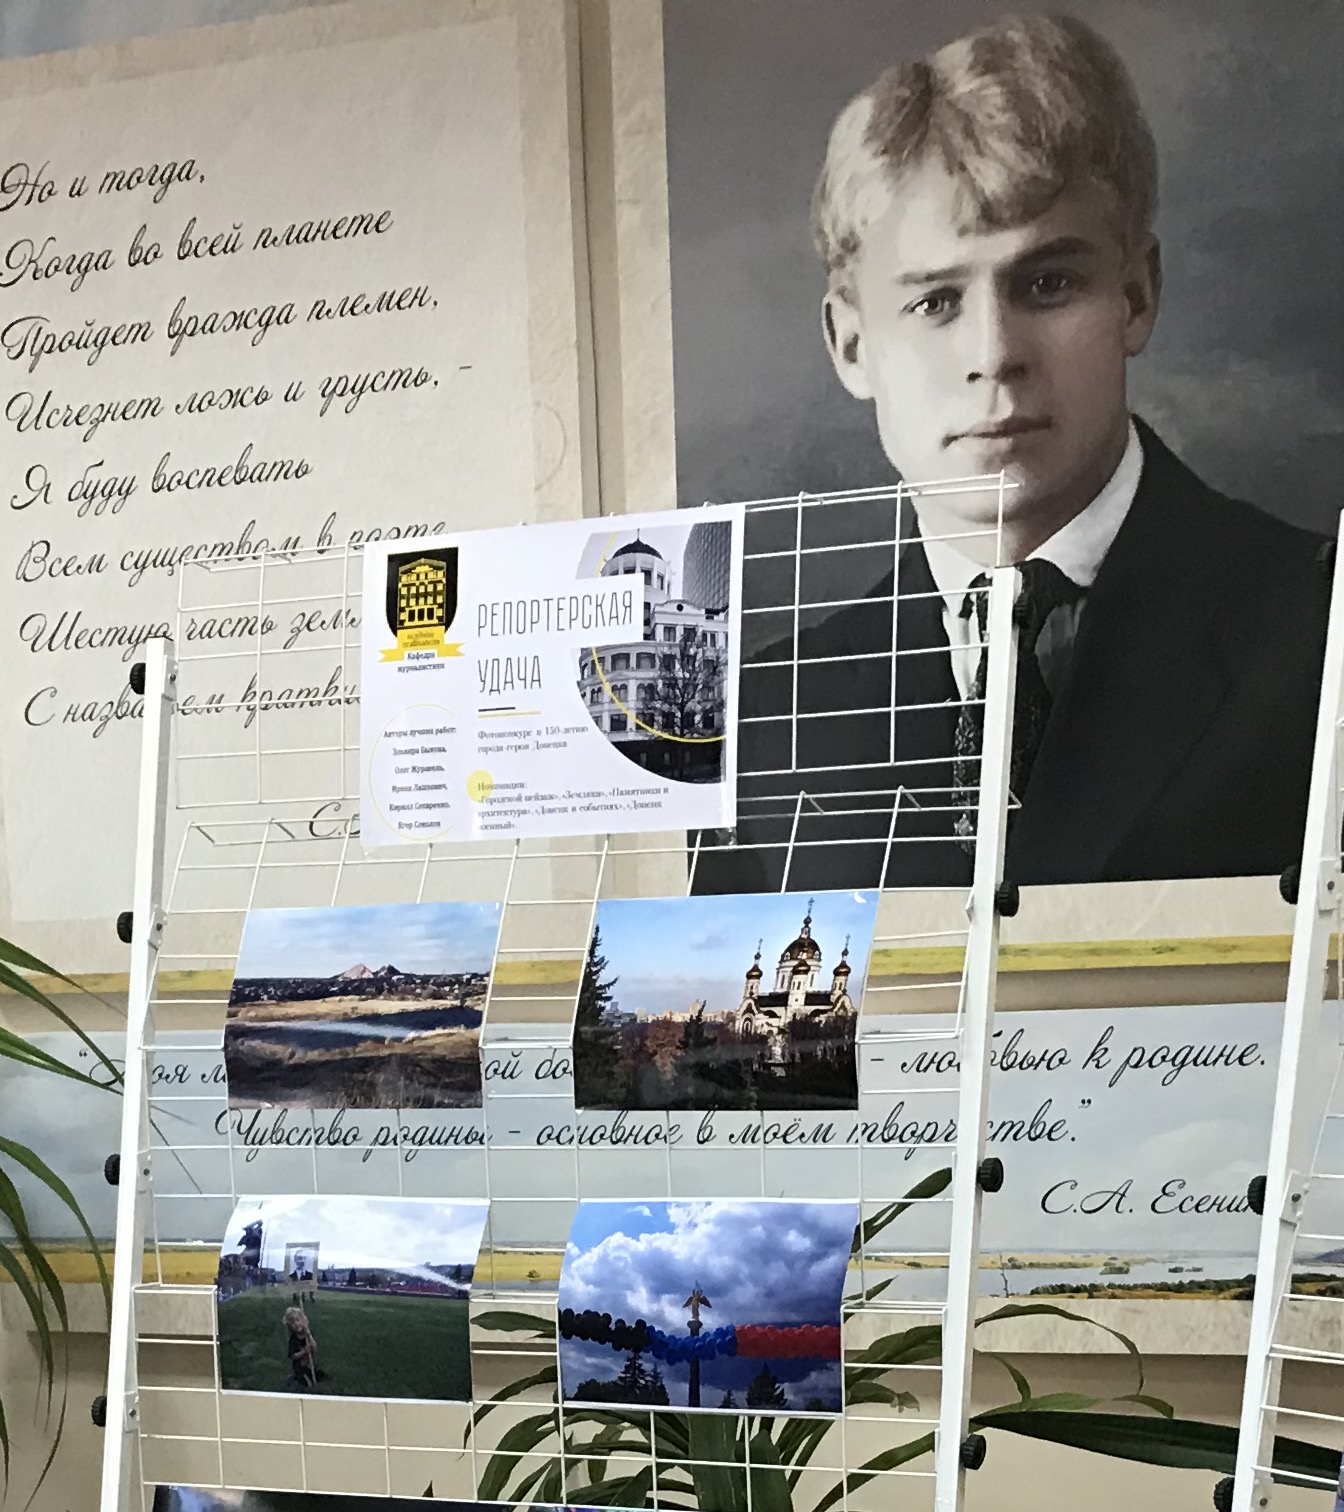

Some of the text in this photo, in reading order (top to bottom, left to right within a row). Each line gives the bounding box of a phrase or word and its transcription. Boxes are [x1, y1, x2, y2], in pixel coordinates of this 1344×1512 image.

[69, 176, 89, 198] и
[99, 159, 205, 204] тогда,
[128, 223, 164, 267] во
[177, 217, 244, 260] всей
[253, 210, 394, 250] планете
[0, 285, 439, 374] Пройдет вражда племен,
[5, 390, 164, 443] Исчезнет
[175, 384, 274, 415] ложь
[284, 381, 306, 403] и
[319, 366, 439, 418] грусть,
[10, 443, 314, 518] Я буду воспевать
[15, 540, 108, 583] Всем
[120, 519, 303, 588] существом
[317, 511, 337, 555] в
[19, 611, 173, 663] Шестую
[186, 613, 278, 642] часть
[478, 590, 632, 637] РЕПОРТЕРСКАЯ
[407, 651, 436, 661] Кафедра
[478, 655, 542, 695] УДАЧА
[24, 686, 57, 727] С
[63, 681, 225, 738] назваем
[384, 730, 408, 738] Авторы
[409, 728, 434, 737] лучших
[532, 741, 567, 751] Донецка
[1082, 1025, 1112, 1070] к
[1114, 1041, 1267, 1088] родине.
[215, 1108, 363, 1163] Чувство
[363, 1124, 493, 1163] родины
[535, 1109, 683, 1146] основное
[695, 1110, 717, 1144] в
[728, 1118, 837, 1145] моём
